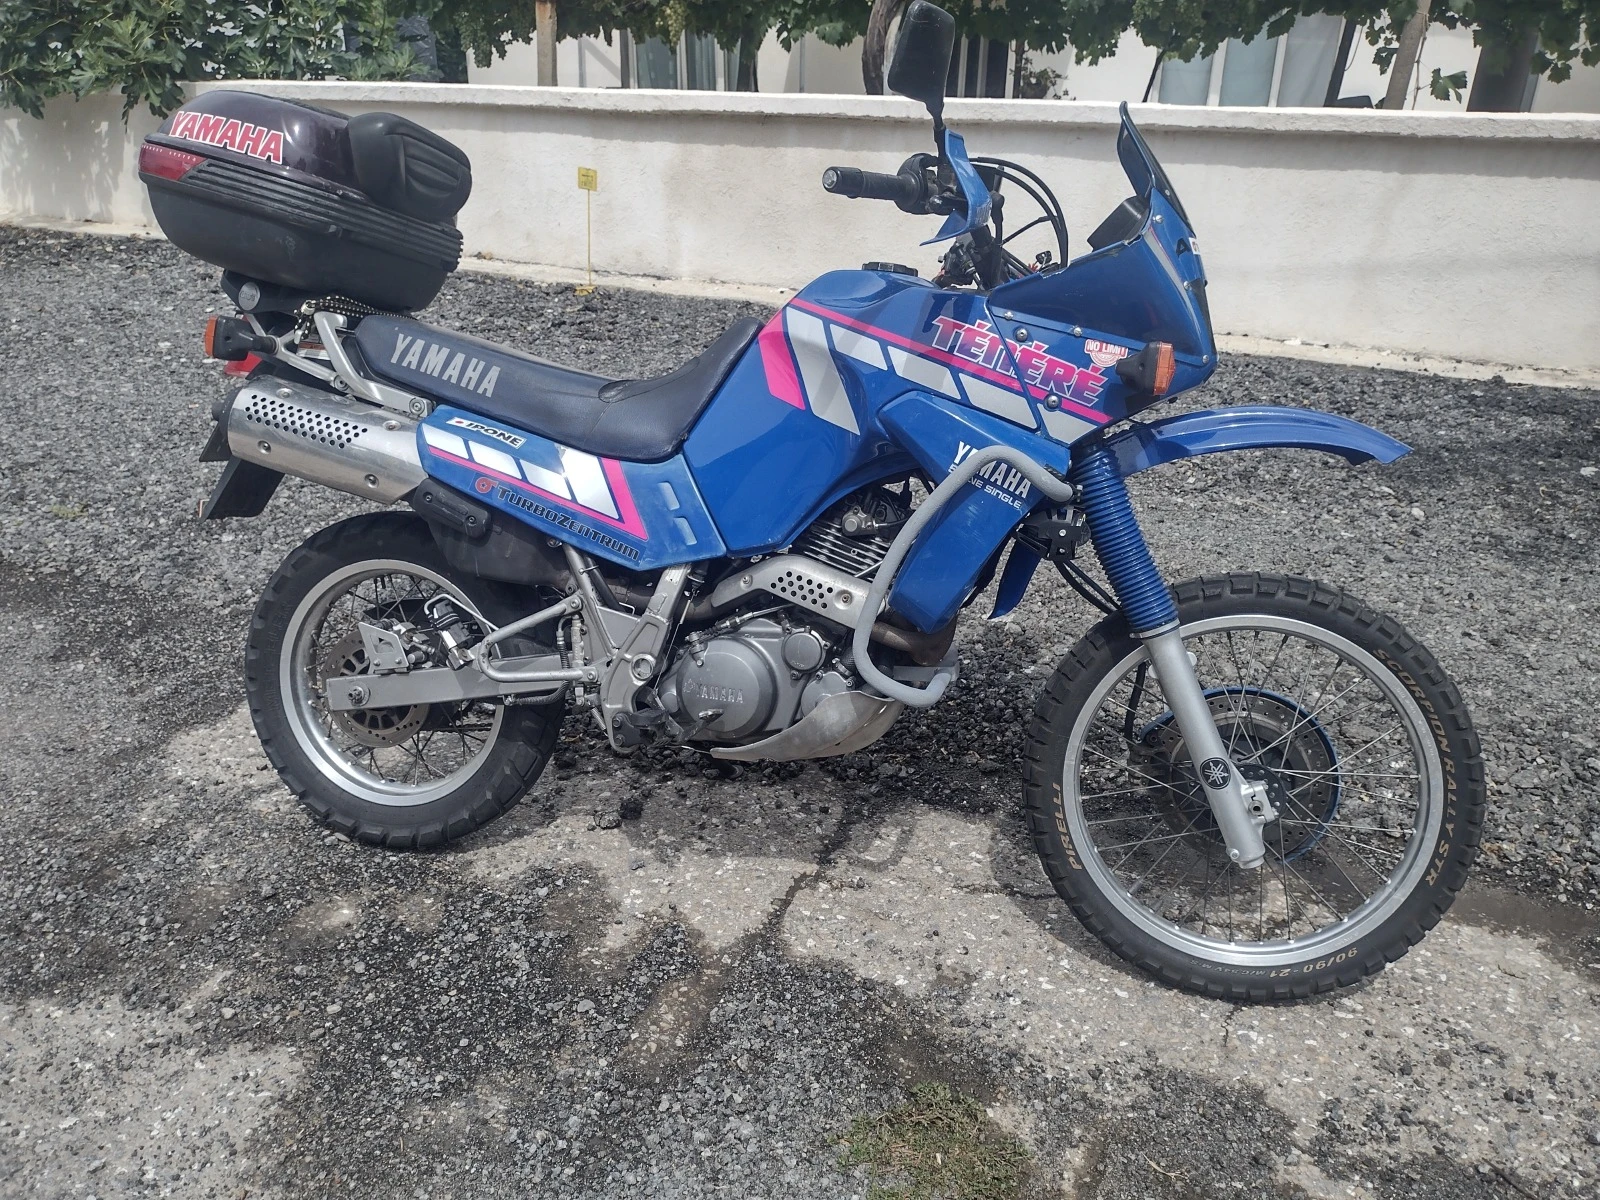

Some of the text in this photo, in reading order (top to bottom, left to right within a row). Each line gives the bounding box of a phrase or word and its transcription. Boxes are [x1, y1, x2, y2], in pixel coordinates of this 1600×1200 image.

[168, 111, 284, 165] YAMAHA
[390, 333, 501, 398] YAMAHA
[931, 315, 1109, 407] TÉNÉRÉ
[1086, 340, 1101, 352] NO
[465, 422, 523, 447] IPONE
[984, 484, 1022, 509] SINGLE
[696, 683, 744, 704] YAMAHA
[1372, 649, 1452, 753] SCORPION
[1443, 757, 1457, 838] RALLY
[1052, 782, 1083, 870] PIRELLI
[1425, 840, 1449, 887] STR
[1269, 967, 1292, 979] 21
[1302, 946, 1358, 974] 90/90
